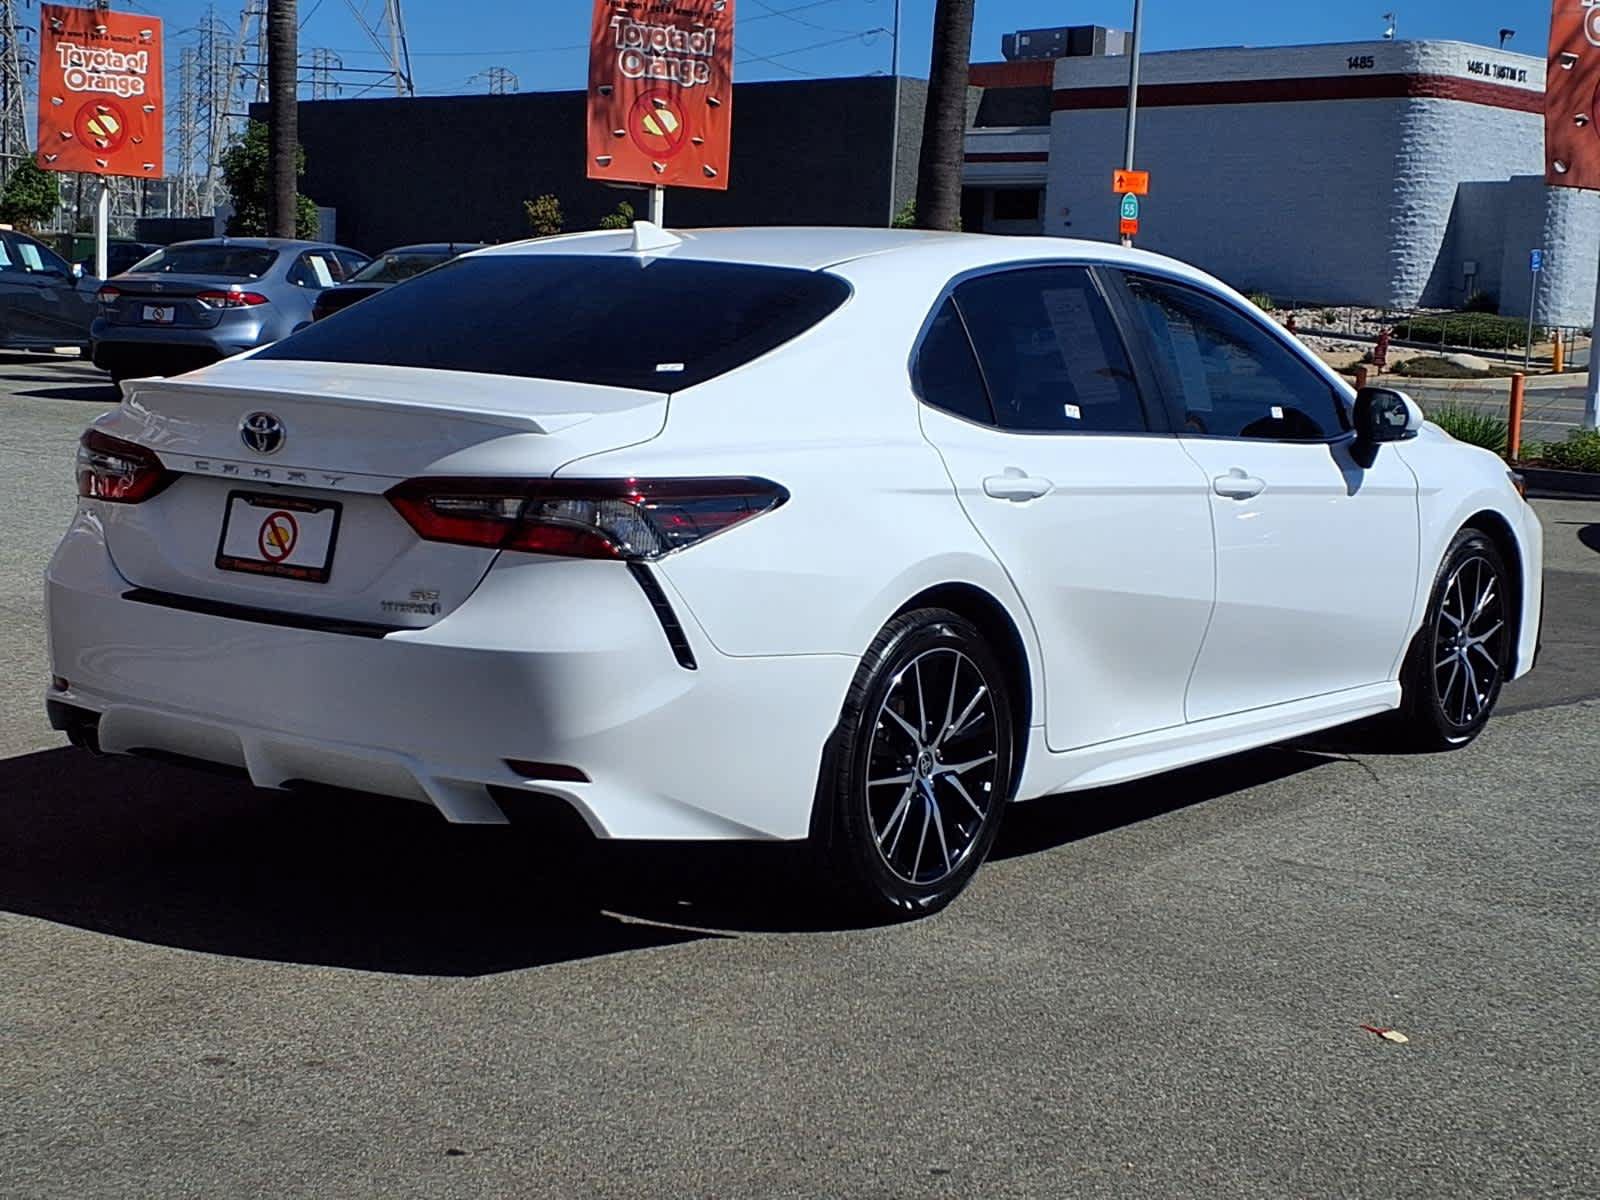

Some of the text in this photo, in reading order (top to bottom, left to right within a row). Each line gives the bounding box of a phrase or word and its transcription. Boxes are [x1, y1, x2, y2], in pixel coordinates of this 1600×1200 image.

[609, 15, 716, 56] Toyota of
[56, 42, 148, 74] Toyota of
[618, 48, 710, 88] Orange
[1346, 55, 1375, 69] 1485
[1467, 60, 1484, 75] 1485
[64, 67, 145, 97] Orange
[1124, 204, 1135, 215] 55
[194, 460, 345, 485] CAMRY
